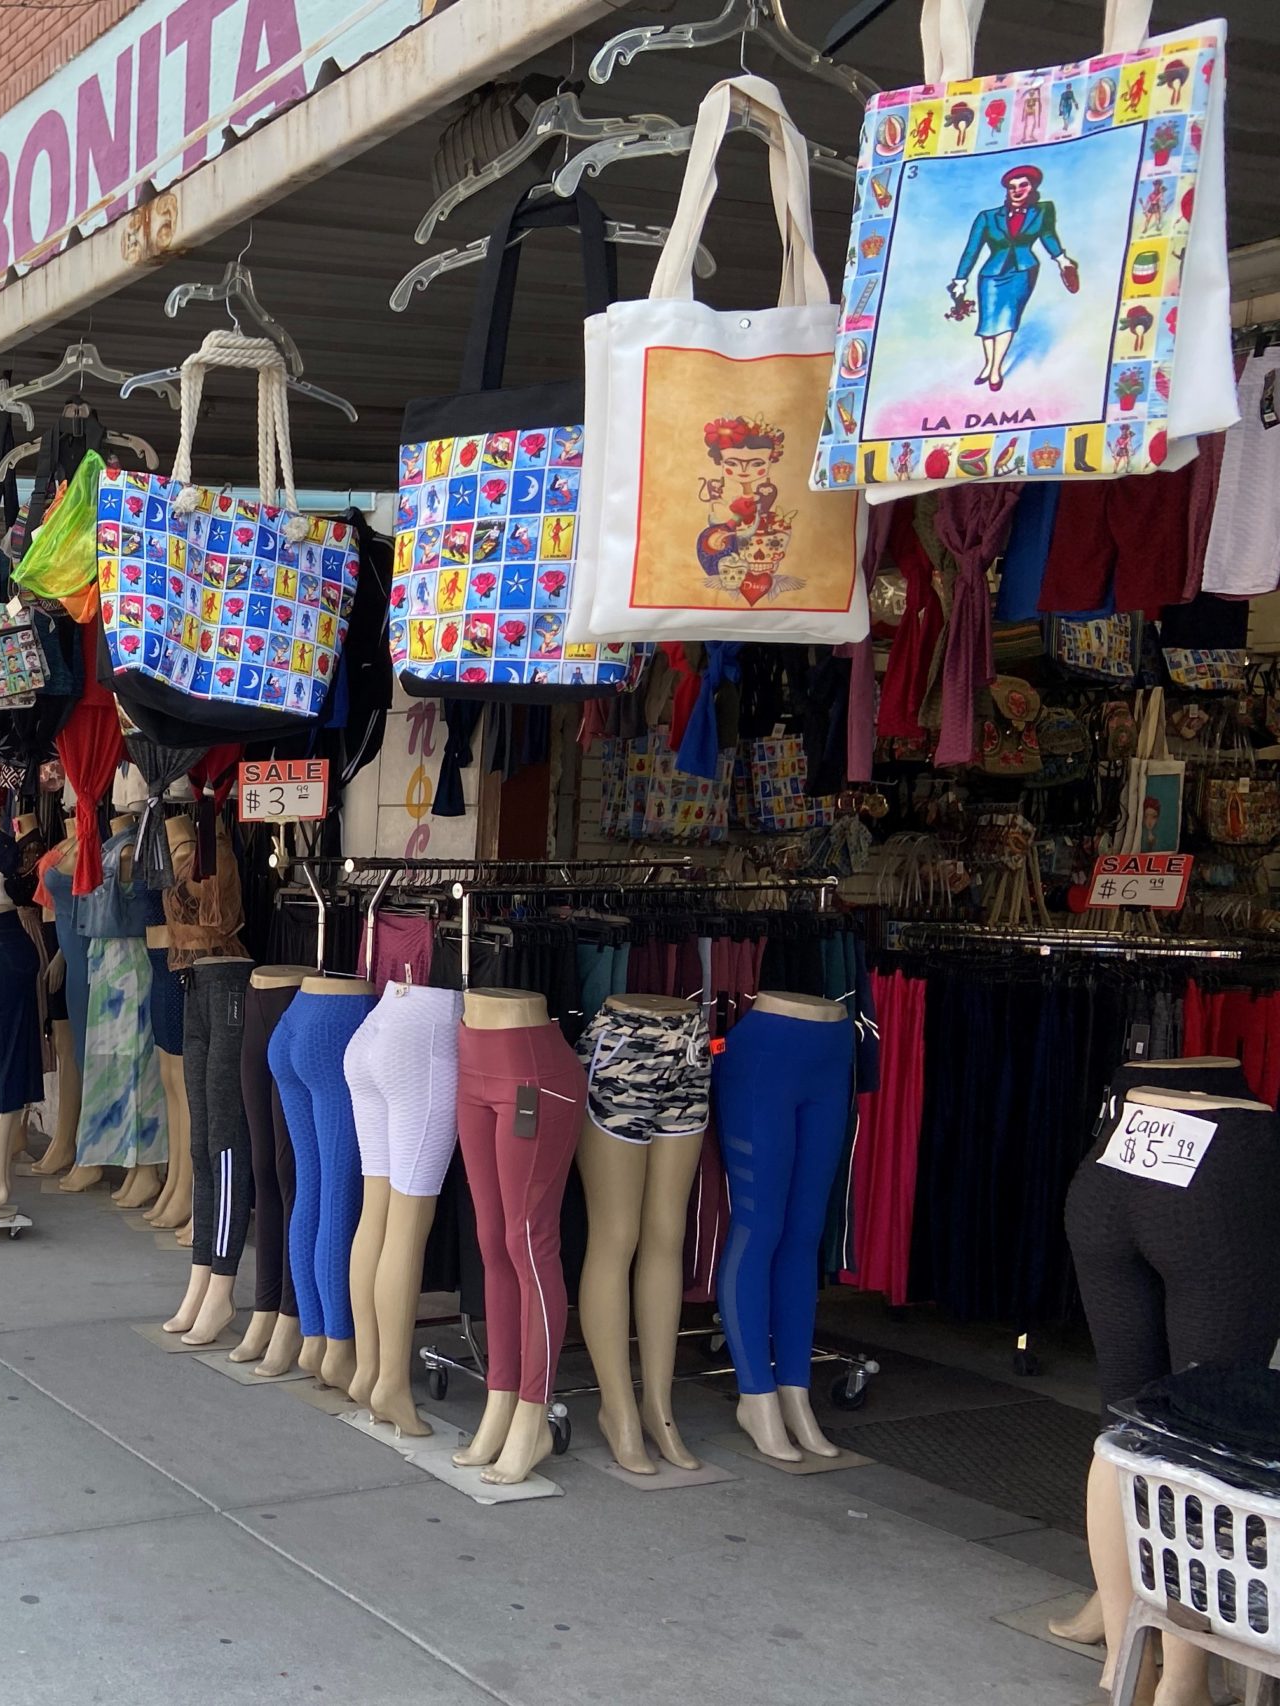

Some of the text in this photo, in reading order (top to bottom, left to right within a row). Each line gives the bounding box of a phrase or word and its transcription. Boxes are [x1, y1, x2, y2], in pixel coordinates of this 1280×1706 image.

[907, 165, 919, 180] 3
[921, 407, 1036, 432] LA DAMA
[244, 761, 323, 783] SALE
[1101, 856, 1185, 874] SALE
[1125, 1109, 1176, 1138] Capri
